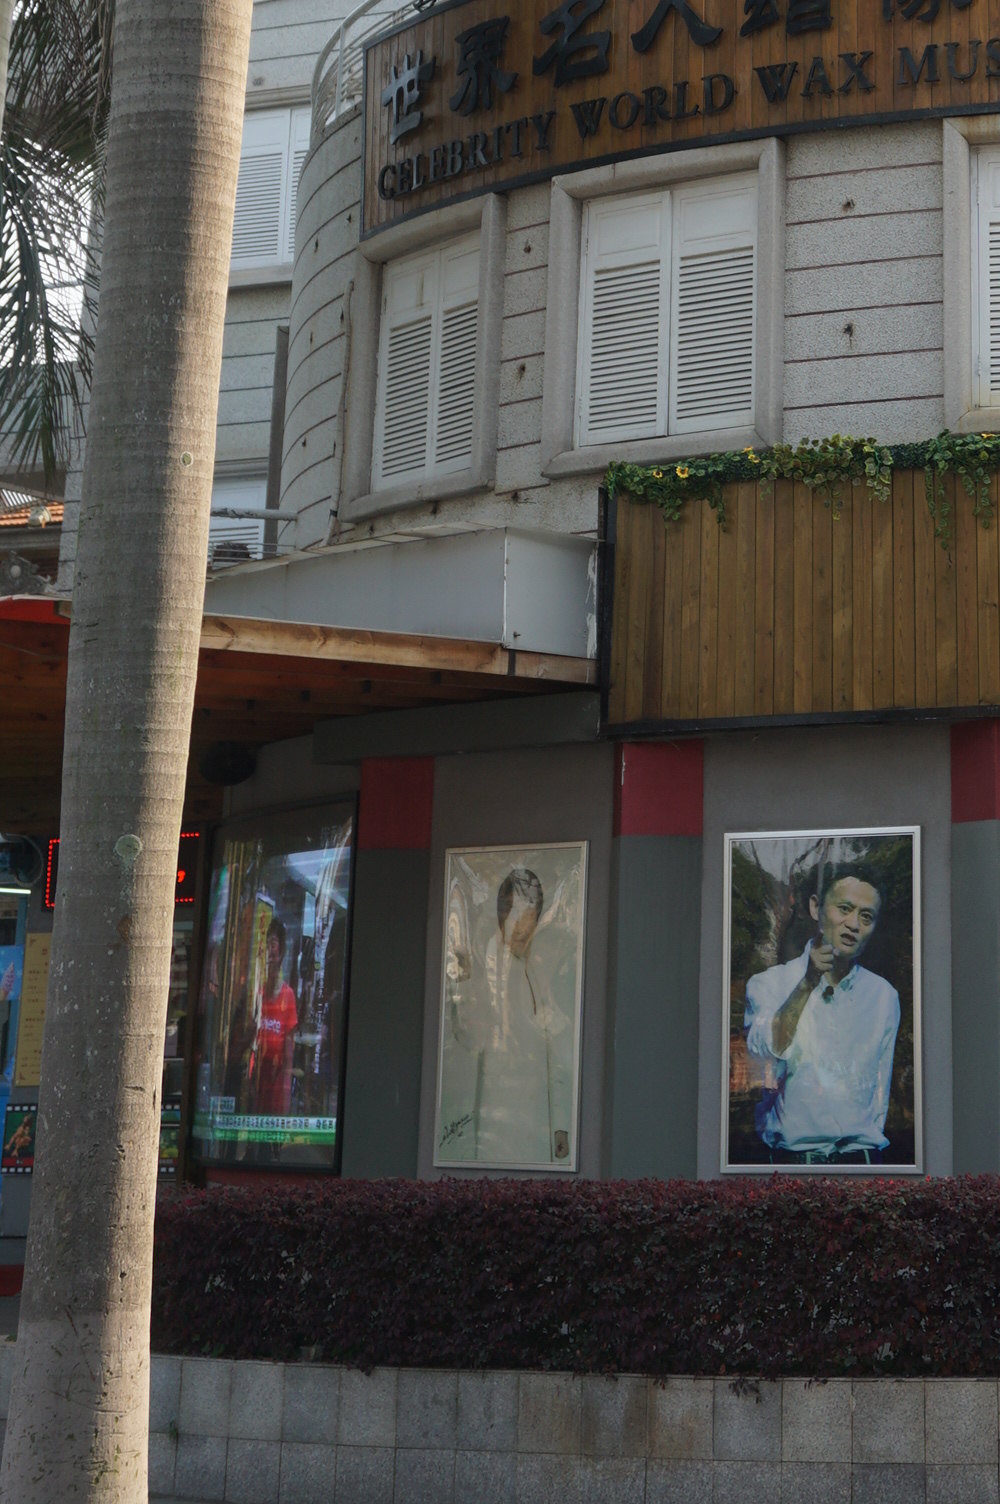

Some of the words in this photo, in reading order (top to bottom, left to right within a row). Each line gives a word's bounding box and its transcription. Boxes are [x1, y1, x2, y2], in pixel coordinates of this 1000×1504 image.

[377, 110, 556, 201] CELEBRITY
[568, 72, 737, 140] WORLD
[752, 50, 876, 104] WAX
